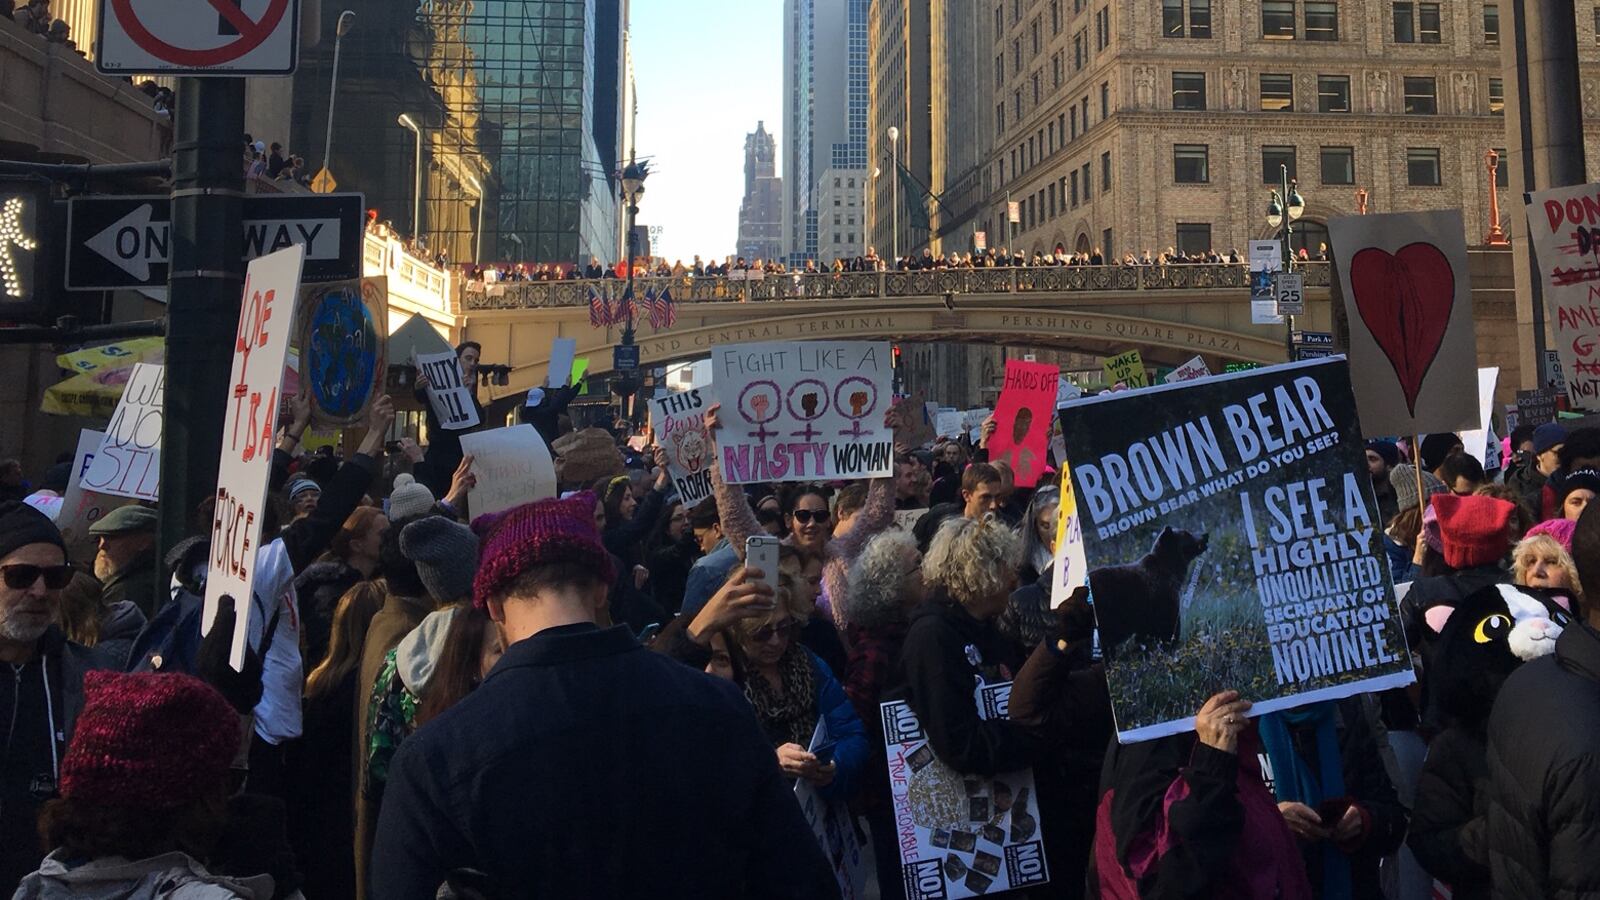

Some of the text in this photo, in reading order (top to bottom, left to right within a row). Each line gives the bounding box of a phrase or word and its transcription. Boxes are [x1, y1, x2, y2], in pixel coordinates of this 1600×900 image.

[115, 223, 324, 259] ON WAY
[1280, 290, 1300, 302] 25
[641, 317, 896, 355] AND CENTRAL TERMINAL
[1001, 315, 1242, 351] PERSHING SQUARE PLAZA
[1307, 335, 1322, 343] Park
[723, 346, 879, 377] FIGHT LIKE A
[1005, 367, 1039, 391] HANDS
[1040, 372, 1059, 393] OFF
[1105, 352, 1140, 371] WAKE
[1116, 366, 1132, 378] UP
[656, 389, 703, 416] THIS
[105, 406, 163, 449] NO
[723, 441, 892, 482] NASTY WOMAN
[1075, 376, 1335, 525] BROWN BEAR
[1098, 431, 1340, 541] BROWN BEAR WHAT DO YOU SEE?
[1239, 472, 1371, 549] I SEE A
[209, 487, 254, 582] FORCE
[1251, 527, 1374, 576] HIGHLY
[1256, 554, 1382, 608] UNQUALIFIED
[1263, 586, 1386, 624] SECRETARY OF
[1267, 603, 1390, 643] EDUCATION
[1270, 623, 1401, 686] NOMINEE.
[895, 703, 922, 740] NO!
[889, 752, 907, 787] TRUE
[893, 792, 920, 864] DEPLORABLE
[917, 860, 943, 900] NO!
[1015, 842, 1041, 884] NO!
